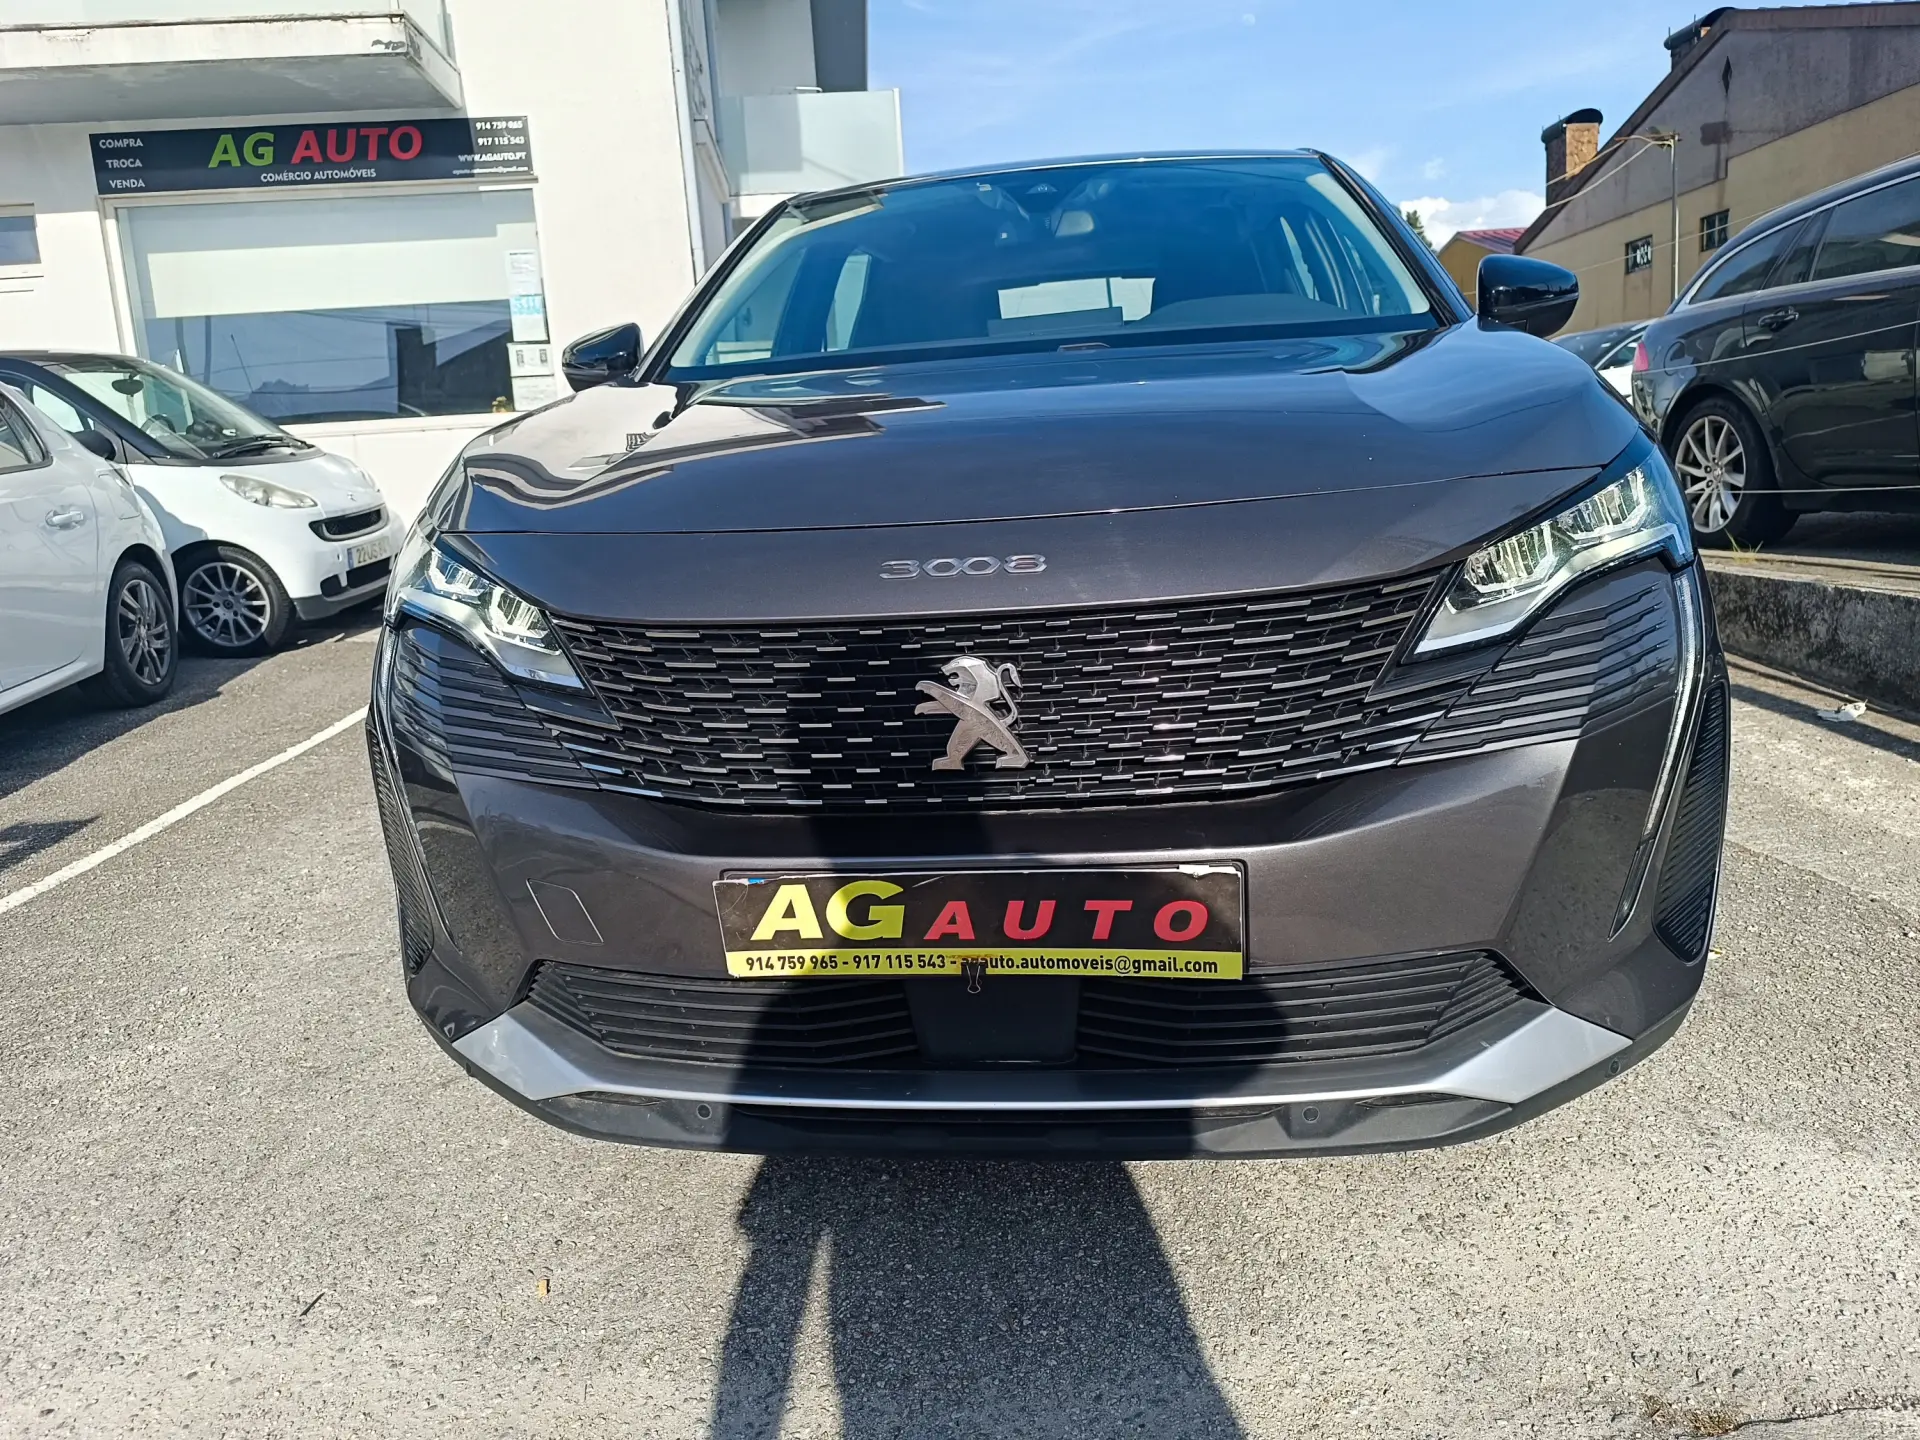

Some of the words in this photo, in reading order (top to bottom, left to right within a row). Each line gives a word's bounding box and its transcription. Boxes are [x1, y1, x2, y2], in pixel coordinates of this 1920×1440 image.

[475, 122, 491, 130] 914
[99, 138, 143, 149] COMPRA
[208, 132, 274, 168] AG
[290, 126, 423, 164] AUTO
[477, 137, 492, 146] 917
[106, 159, 142, 169] TROCA
[260, 169, 312, 183] COMÉRCIO
[313, 166, 376, 180] AUTOMÓVEIS
[109, 178, 145, 189] VENDA
[880, 554, 1047, 579] 3008
[750, 880, 904, 941] AG
[923, 900, 1208, 941] AUTO
[746, 956, 774, 971] 914
[777, 956, 806, 970] 759
[810, 955, 838, 970] 965
[853, 954, 879, 969] 917
[888, 954, 914, 969] 115
[917, 954, 946, 969] 543
